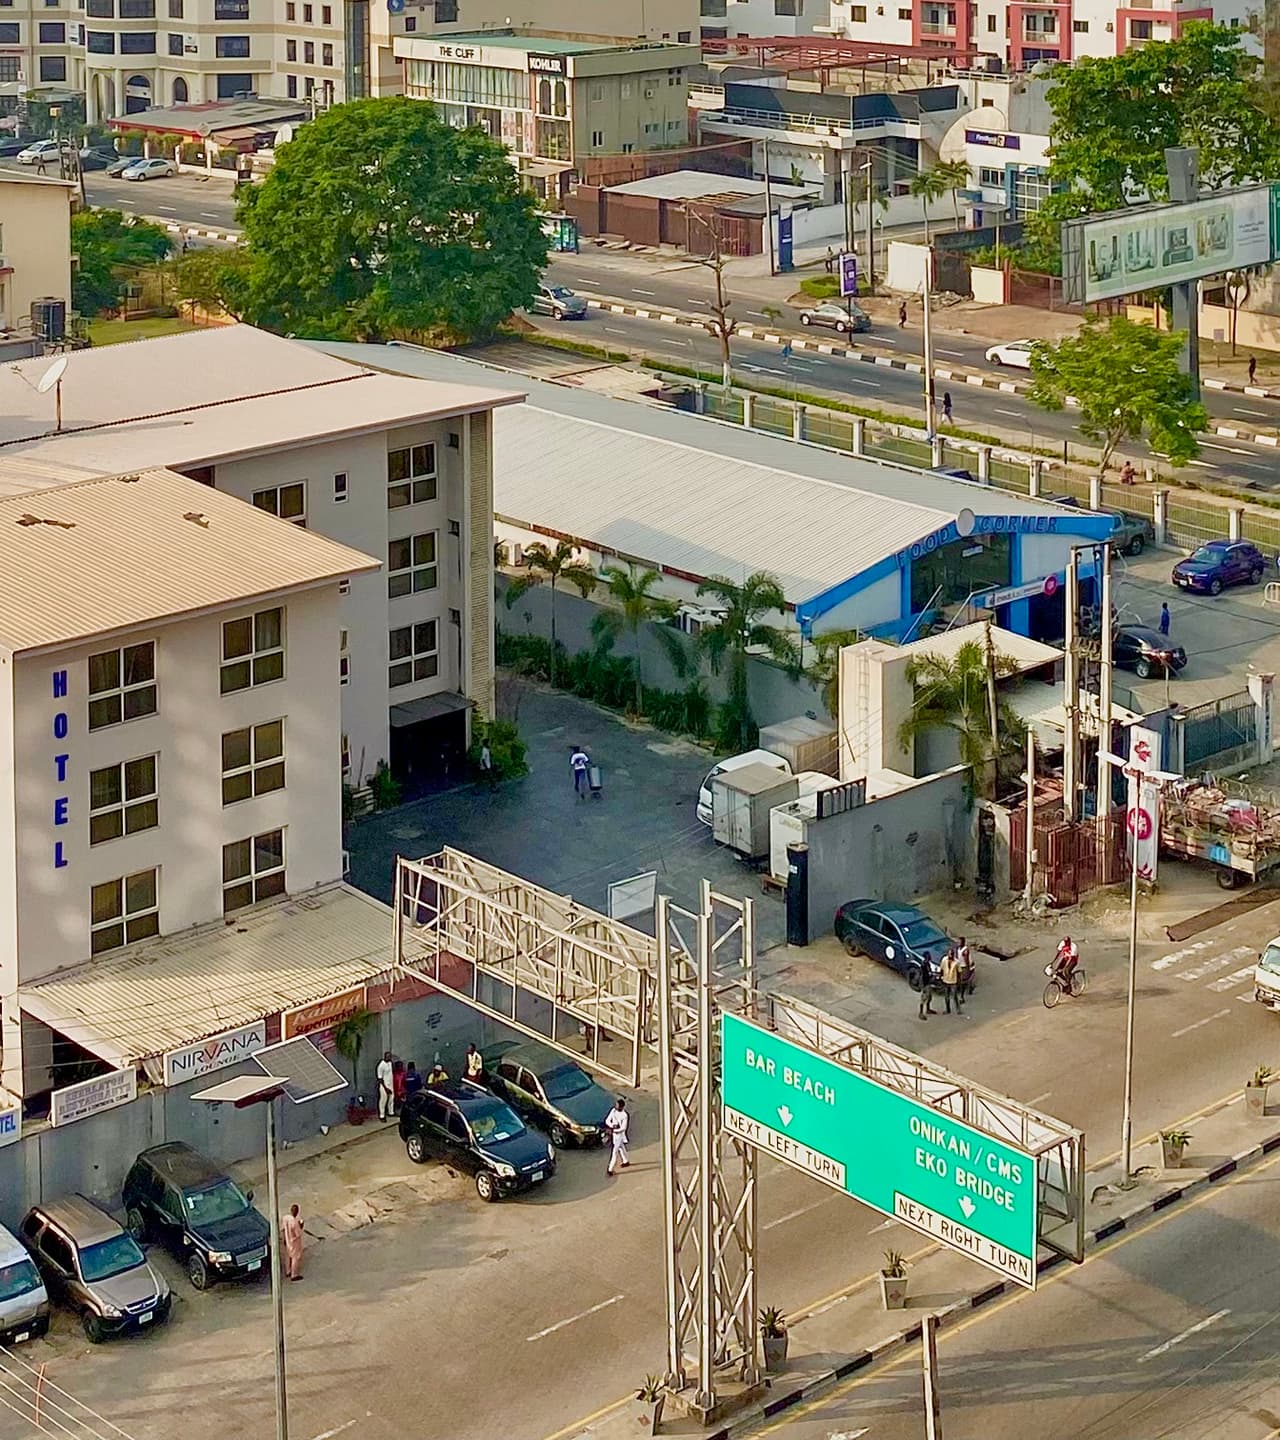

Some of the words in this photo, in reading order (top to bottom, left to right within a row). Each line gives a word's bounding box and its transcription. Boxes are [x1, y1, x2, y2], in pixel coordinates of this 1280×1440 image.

[439, 45, 454, 57] THE
[529, 56, 562, 73] KOHLER
[895, 527, 950, 570] FOOD
[980, 515, 1058, 533] CORNER
[52, 670, 69, 869] HOTEL
[295, 1005, 358, 1035] Supermarket
[171, 1031, 262, 1074] NIRVANA
[745, 1048, 775, 1077] BAR
[783, 1065, 835, 1105] BEACH
[730, 1113, 760, 1139] NEXT
[768, 1131, 799, 1158] LEFT
[806, 1150, 841, 1181] TURN
[909, 1116, 970, 1160] ONIKAN
[986, 1152, 1022, 1185] CMS
[916, 1147, 947, 1177] EKO
[955, 1167, 1015, 1212] BRIDGE
[899, 1198, 933, 1228] NEXT
[941, 1220, 982, 1253] RIGHT
[989, 1244, 1028, 1277] TURN
